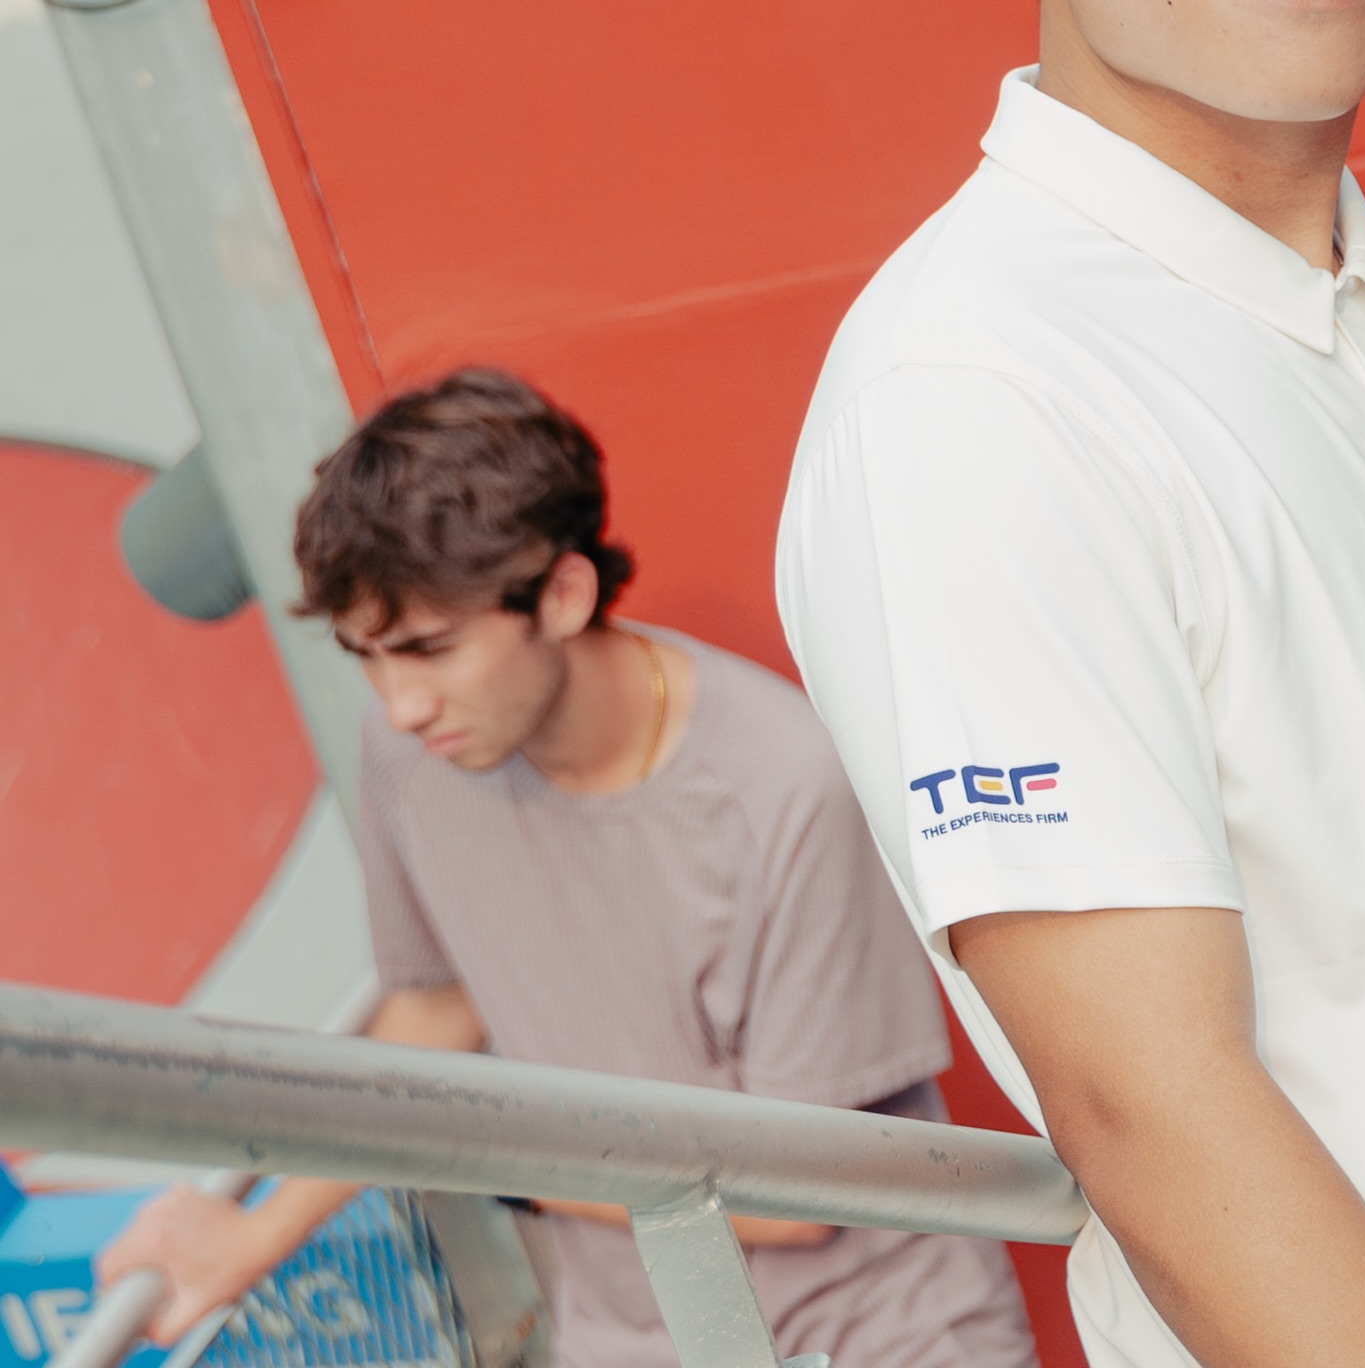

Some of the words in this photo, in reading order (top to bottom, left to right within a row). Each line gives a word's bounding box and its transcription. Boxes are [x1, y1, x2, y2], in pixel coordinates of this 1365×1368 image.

[909, 762, 1061, 815] TEF
[921, 823, 948, 840] THE
[949, 810, 1034, 831] EXPERIENCES
[1035, 811, 1069, 824] FIRM
